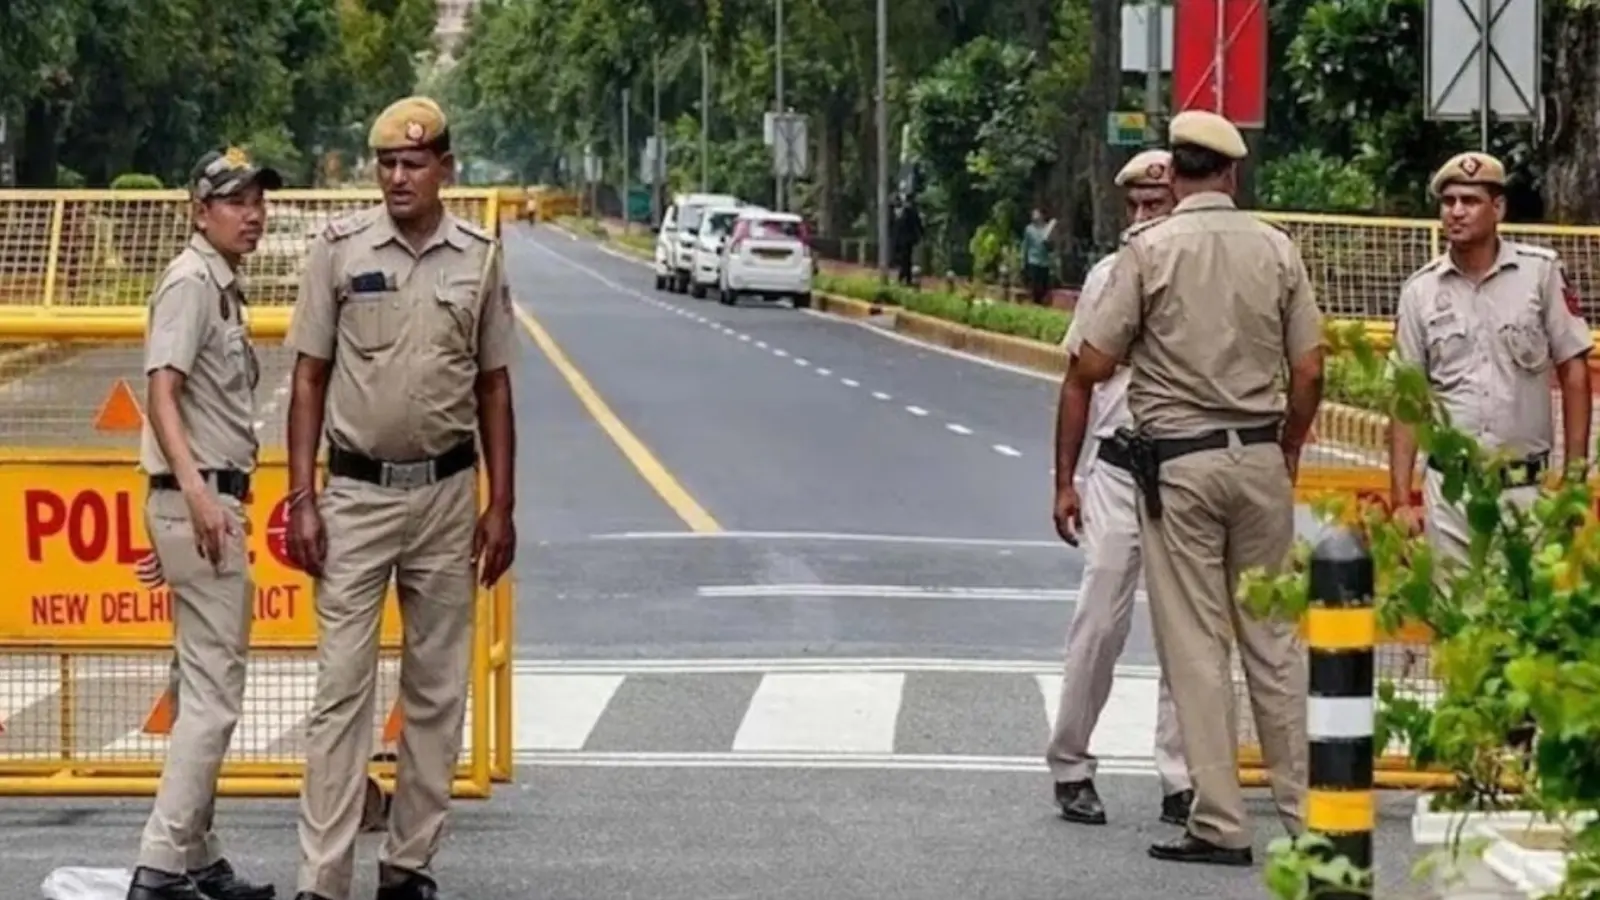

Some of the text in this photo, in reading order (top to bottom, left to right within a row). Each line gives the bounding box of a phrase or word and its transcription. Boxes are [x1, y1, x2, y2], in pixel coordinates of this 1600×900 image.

[25, 489, 256, 564] POL
[31, 591, 173, 624] NEW DELHI
